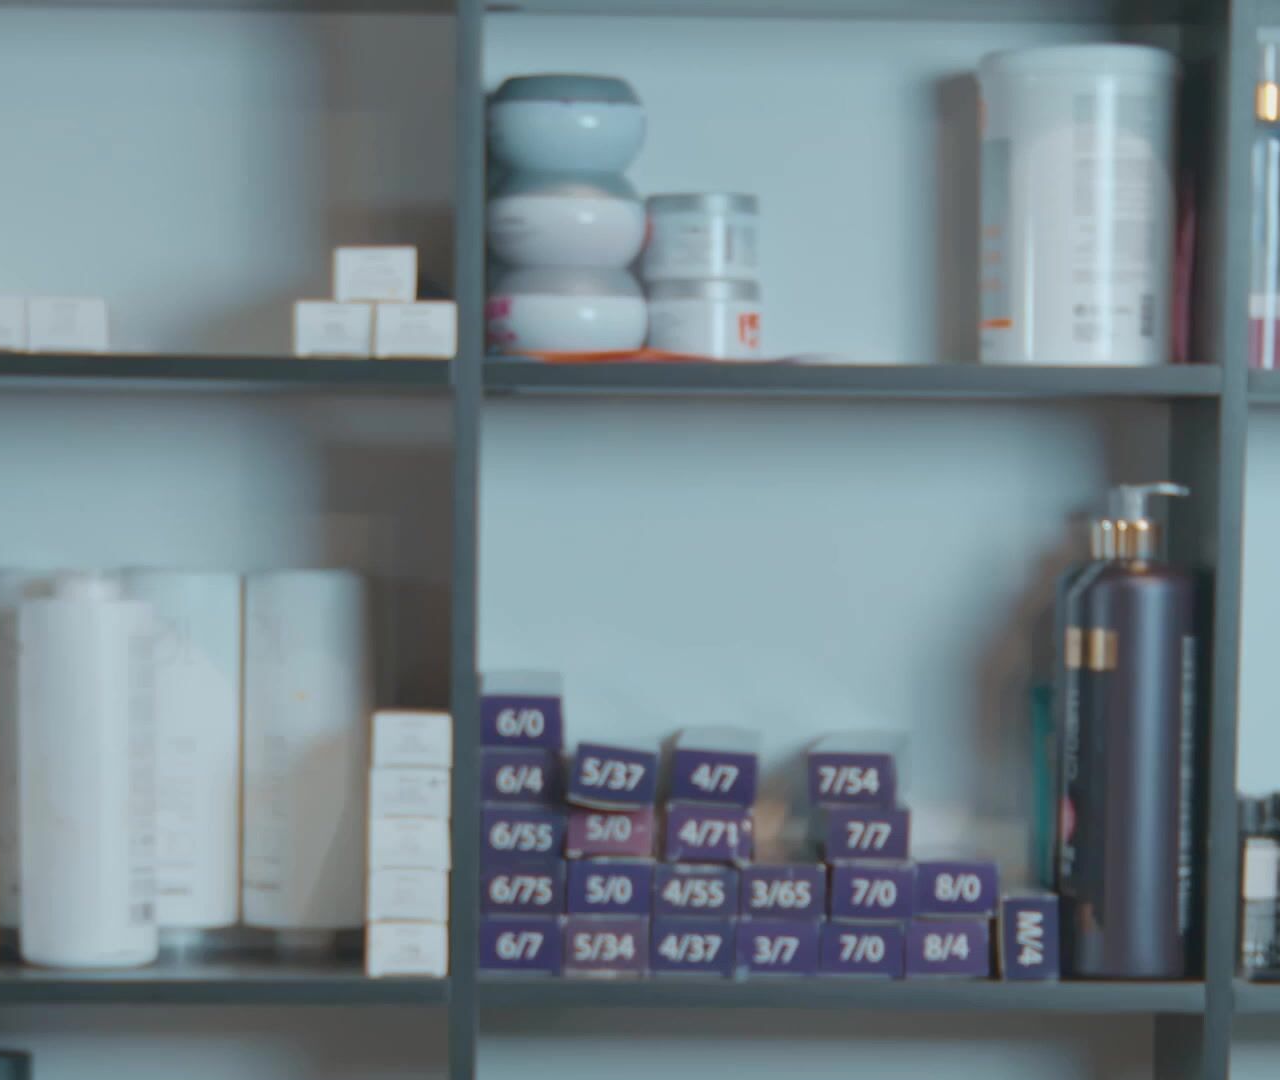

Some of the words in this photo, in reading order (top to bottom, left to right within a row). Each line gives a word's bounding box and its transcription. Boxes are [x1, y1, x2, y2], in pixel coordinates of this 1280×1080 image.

[496, 708, 544, 737] 6/0
[496, 765, 543, 793] 6/4
[581, 757, 645, 791] 5/37
[691, 763, 739, 792] 4/7
[819, 766, 879, 794] 7/54
[490, 822, 552, 850] 6/55
[586, 815, 632, 841] 5/0
[679, 819, 738, 847] 4/71
[847, 821, 891, 849] 7/7
[490, 876, 552, 904] 6/75
[586, 875, 632, 904] 5/0
[663, 879, 724, 907] 4/55
[751, 880, 811, 908] 3/65
[852, 879, 896, 907] 7/0
[935, 873, 981, 902] 8/0
[496, 932, 543, 960] 6/7
[575, 933, 635, 960] 5/34
[659, 934, 722, 962] 4/37
[754, 935, 799, 963] 3/7
[840, 935, 884, 962] 7/0
[923, 934, 969, 960] 8/4
[1017, 911, 1043, 966] M/4
